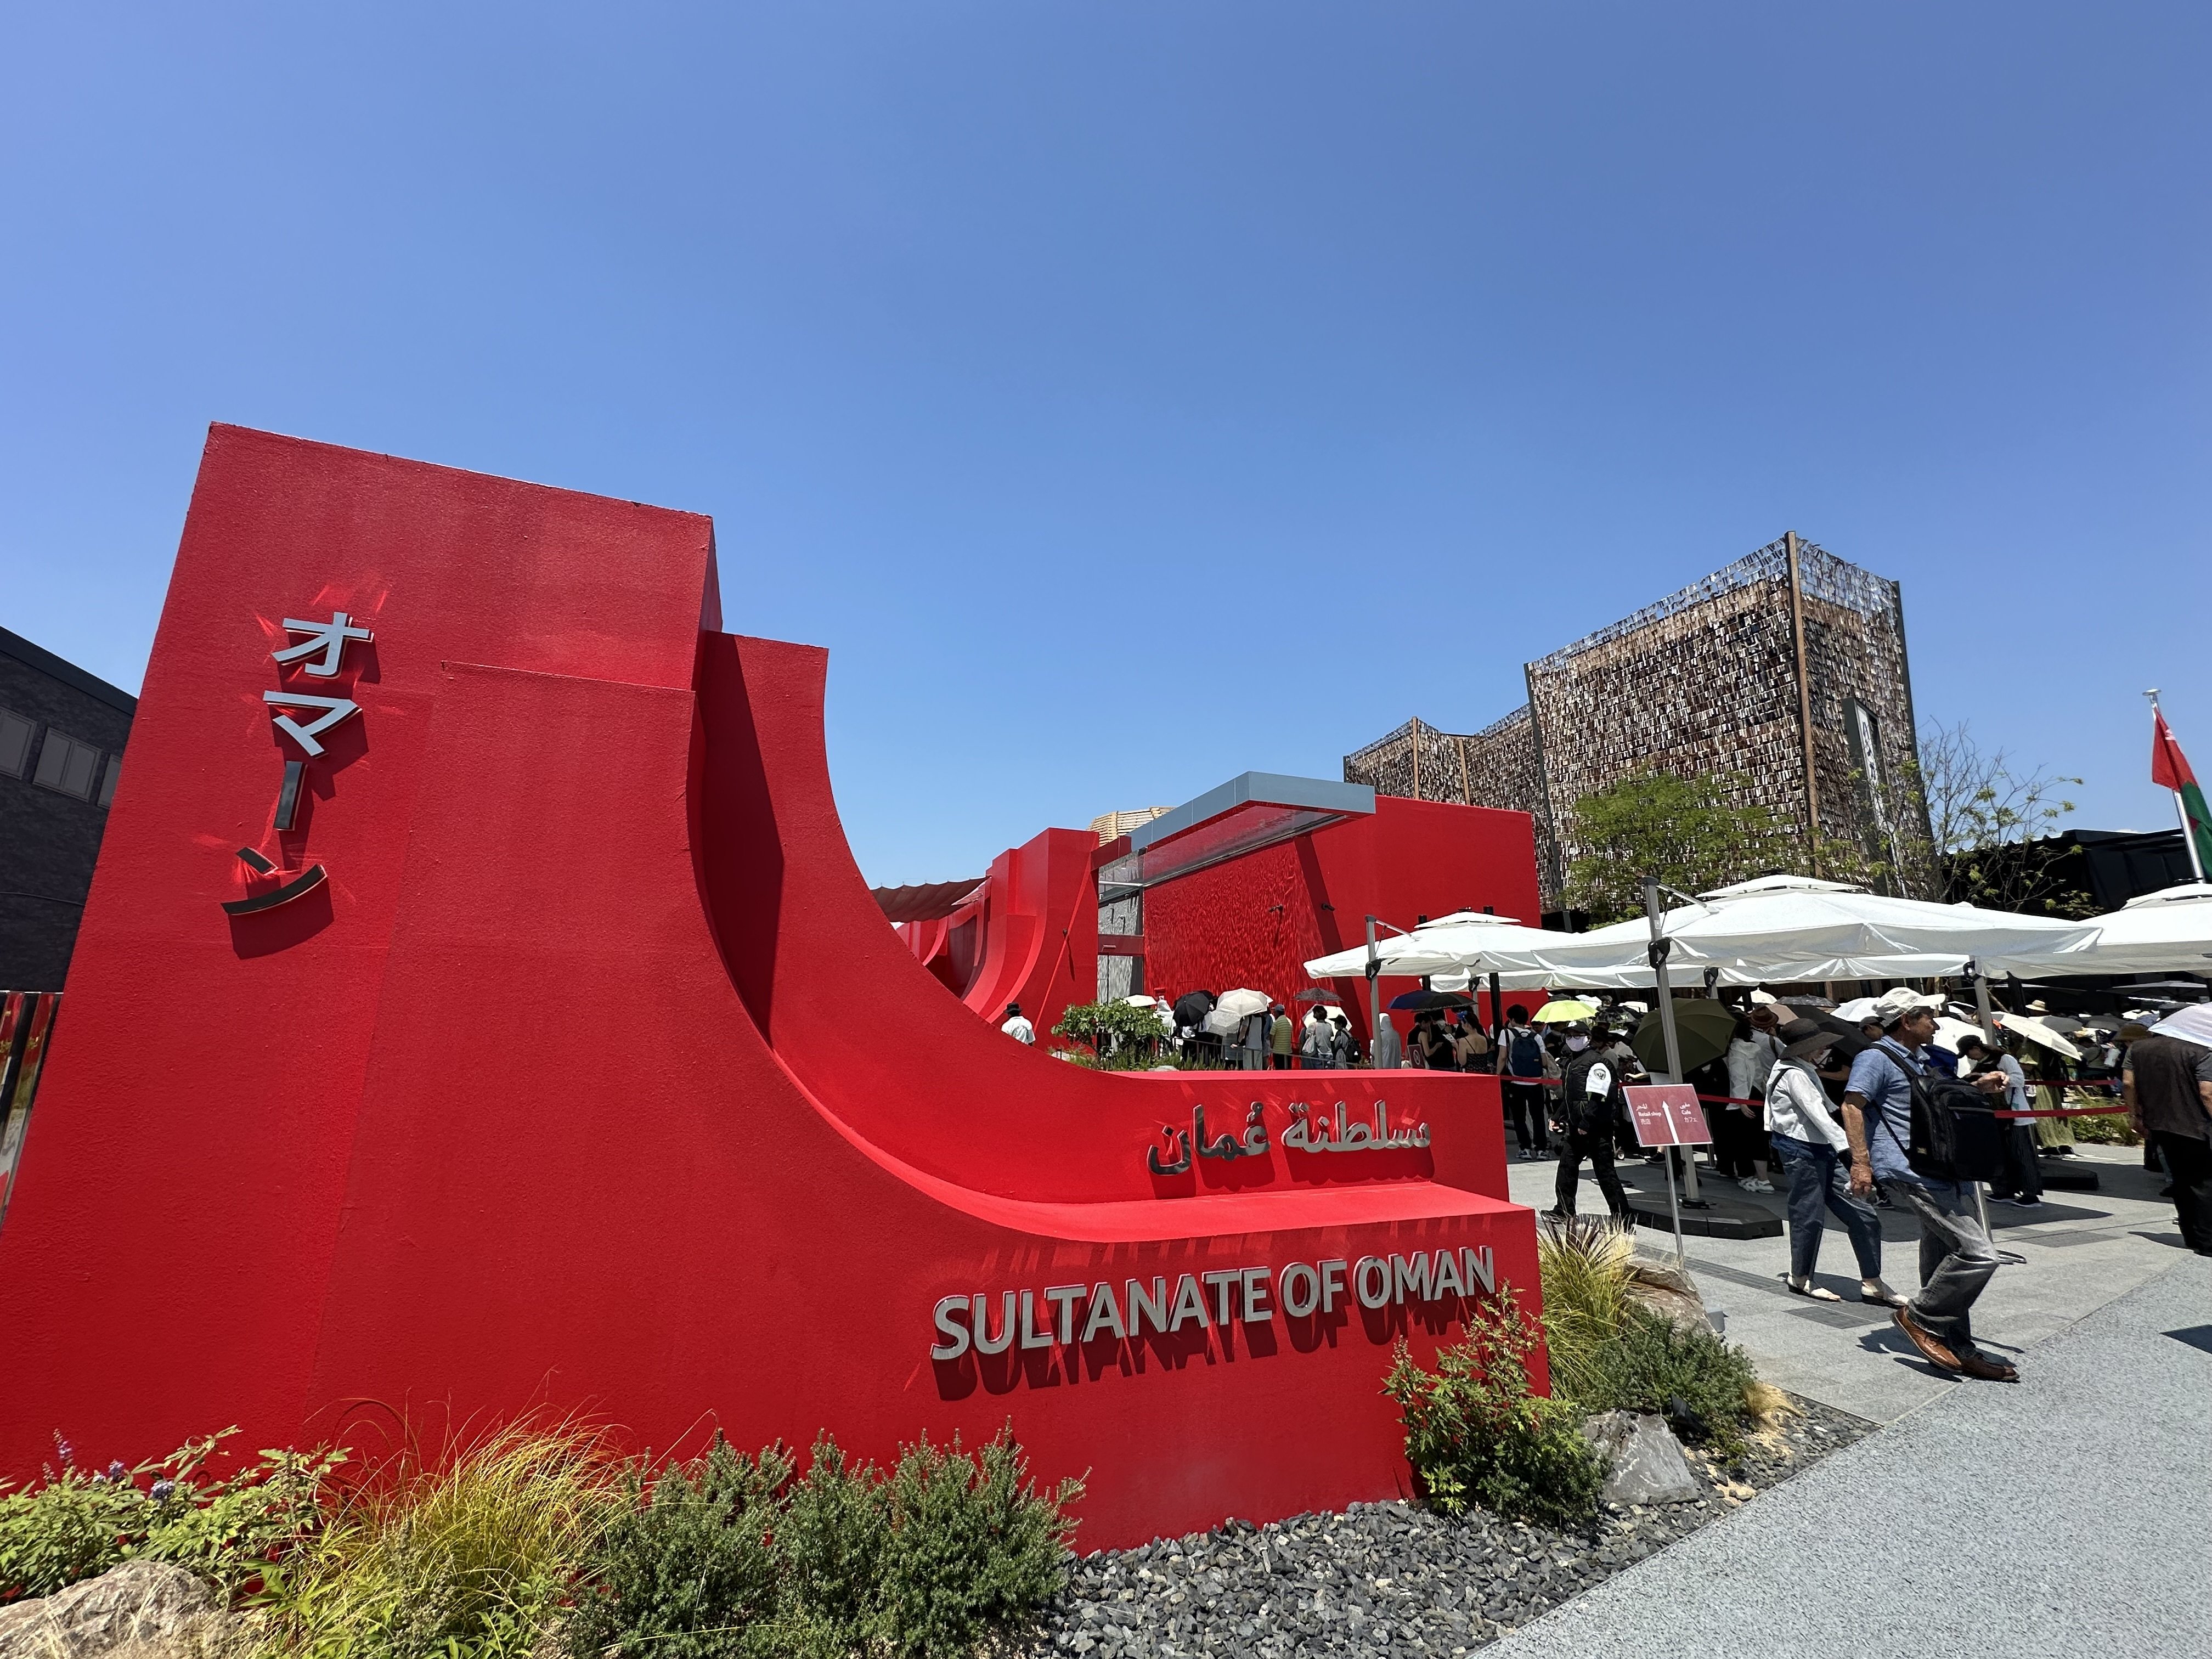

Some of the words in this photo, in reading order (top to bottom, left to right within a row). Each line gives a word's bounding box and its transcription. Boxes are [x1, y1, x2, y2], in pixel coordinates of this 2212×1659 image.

[221, 611, 375, 915] オマーン
[1281, 1099, 1431, 1153] سلطنة
[930, 1266, 1273, 1361] SULTANATE
[1278, 1258, 1347, 1317] OF
[1352, 1245, 1496, 1309] OMAN
